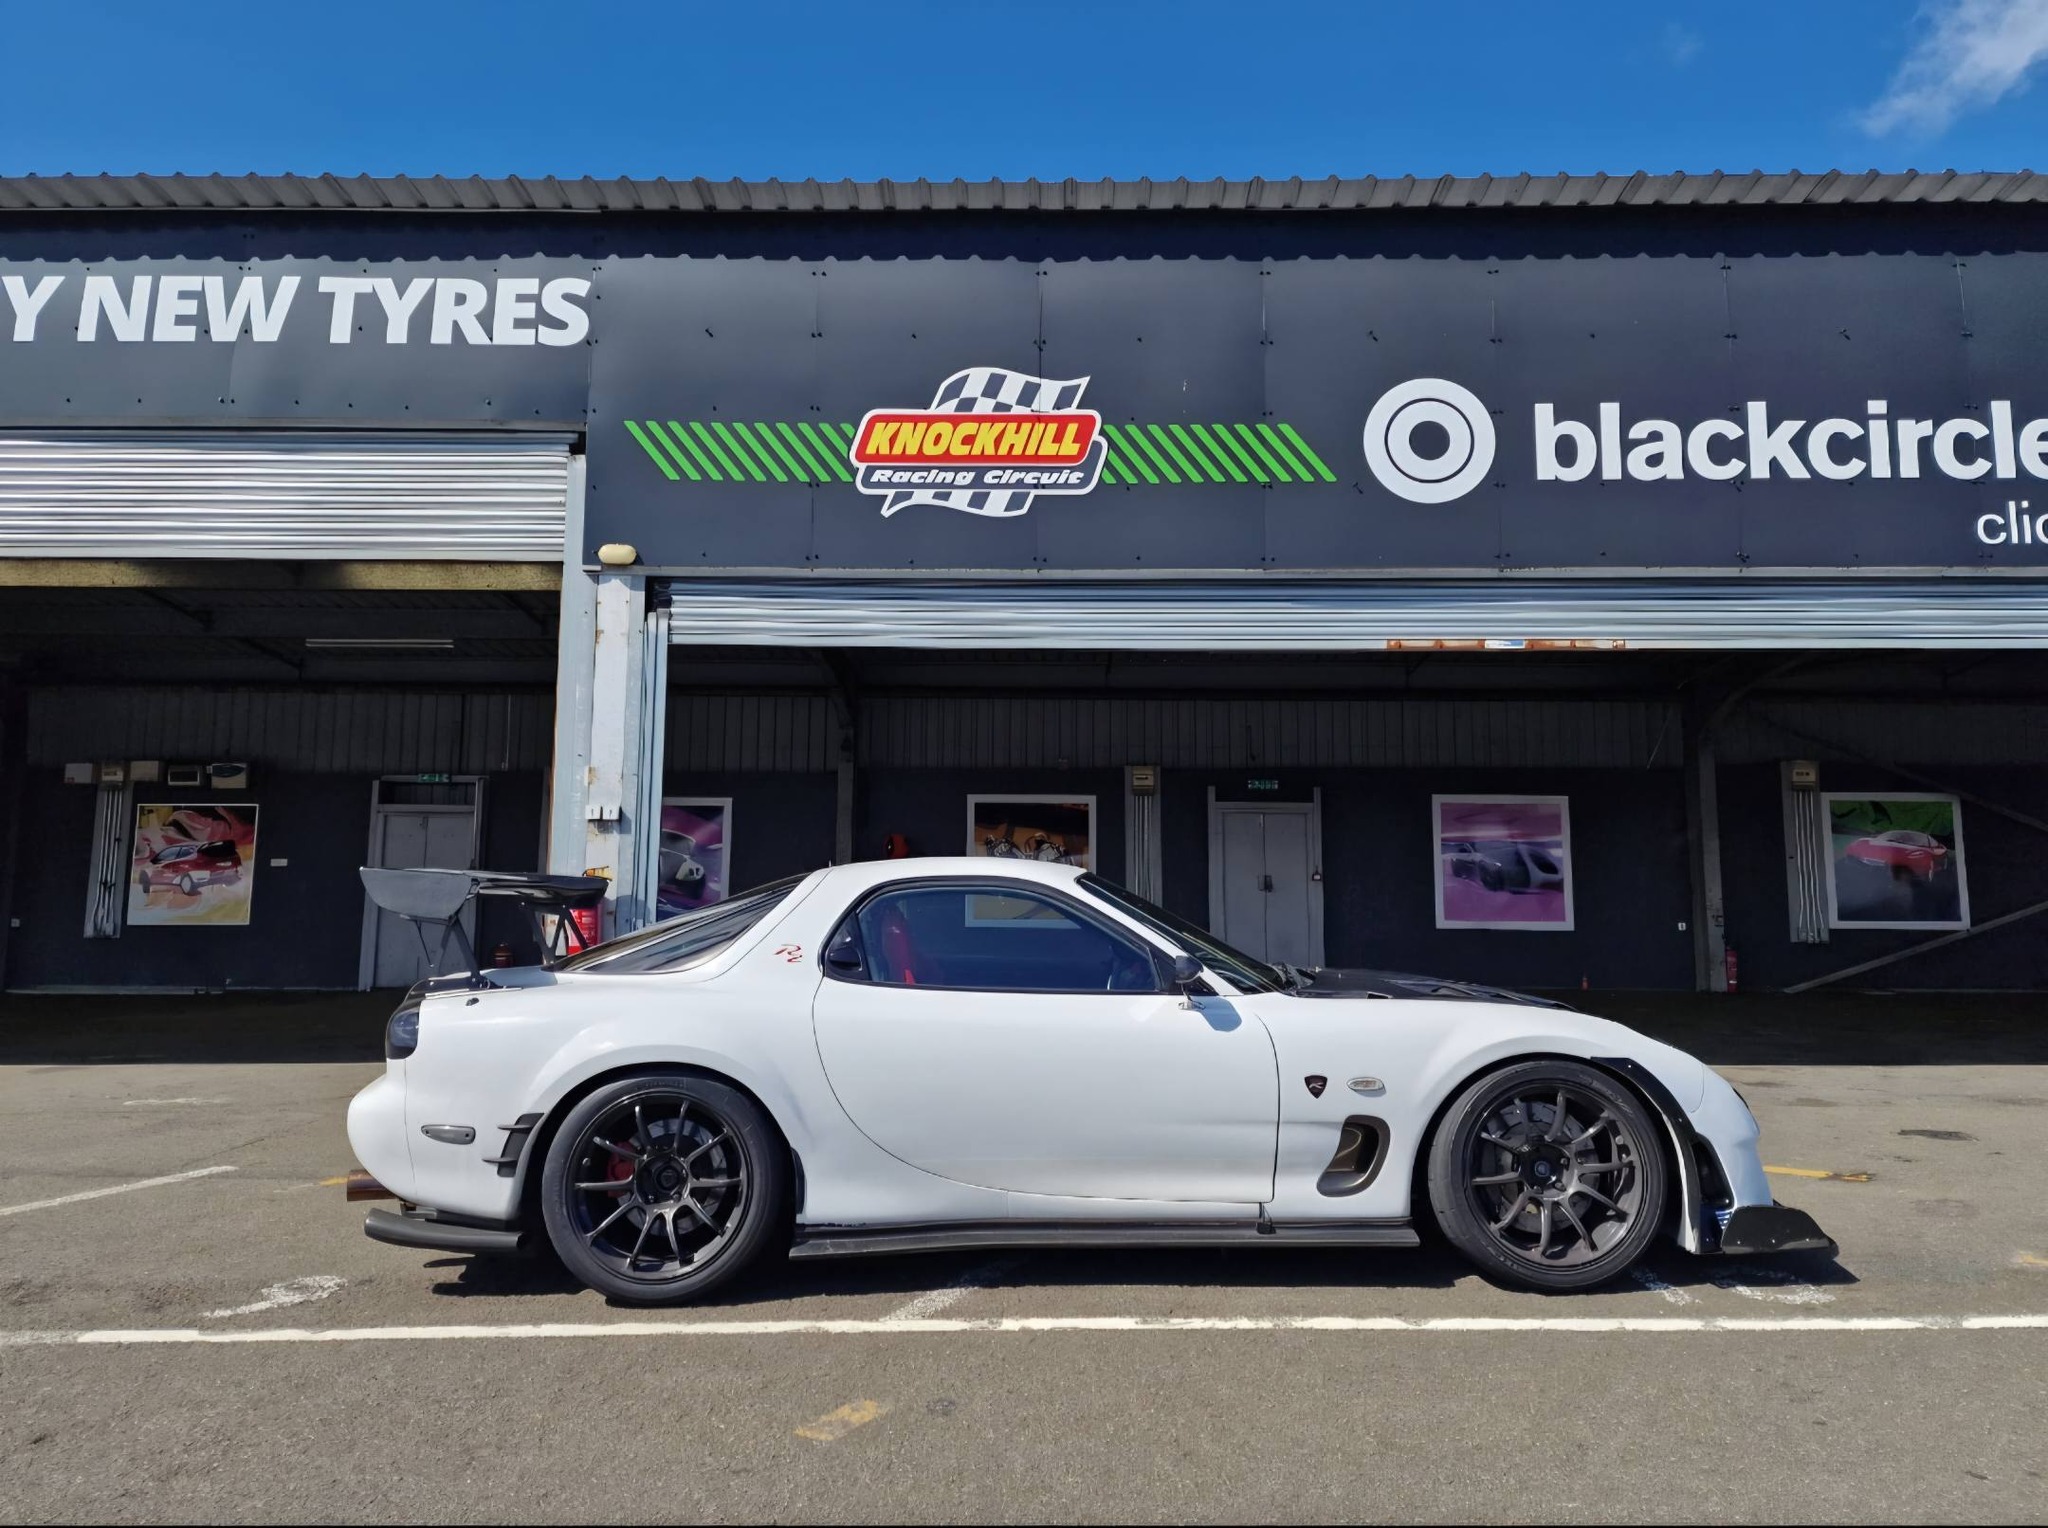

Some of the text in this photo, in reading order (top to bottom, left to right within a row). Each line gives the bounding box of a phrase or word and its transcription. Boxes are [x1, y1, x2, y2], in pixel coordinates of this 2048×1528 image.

[2, 275, 591, 346] Y NEW TYRES
[866, 422, 1081, 456] KNOCKHILL
[869, 469, 1085, 486] Racing Circuit
